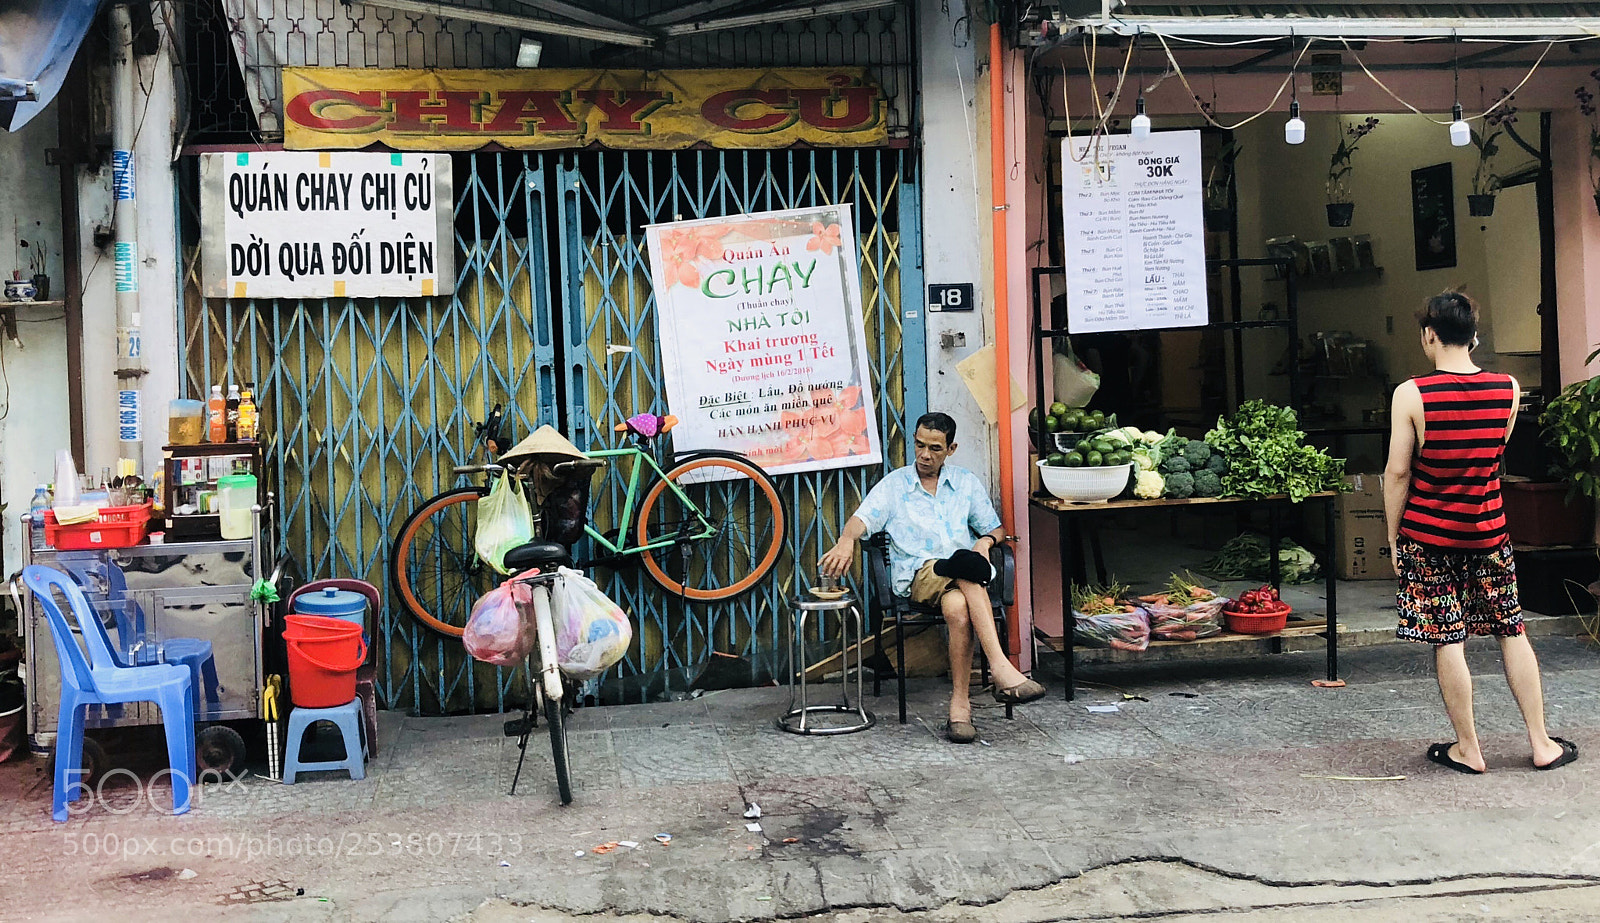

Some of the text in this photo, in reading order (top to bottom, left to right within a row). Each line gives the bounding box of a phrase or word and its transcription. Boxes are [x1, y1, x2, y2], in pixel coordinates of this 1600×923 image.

[286, 73, 879, 134] CHAY CỦ
[1146, 165, 1174, 178] 30K
[229, 157, 431, 220] QUÁN CHAY CHỊ CỦ
[230, 228, 434, 282] DỜI QUA ĐỐI DIỆN
[723, 241, 790, 264] Quán Ăn
[701, 258, 817, 298] CHAY
[770, 297, 794, 308] chay)
[940, 288, 962, 306] 18
[726, 308, 810, 333] NHÀ TÔI
[724, 333, 818, 353] Khai trương
[706, 342, 835, 375] Ngày mùng 1 Tết
[777, 367, 814, 379] 16/2/2018)
[699, 394, 720, 407] Đặc
[724, 390, 748, 404] Biệt
[788, 380, 804, 395] Đồ
[807, 379, 843, 392] nướng
[709, 394, 833, 420] Các món ăn miền quê
[718, 414, 836, 438] HÂN HẠNH PHỤC VỤ
